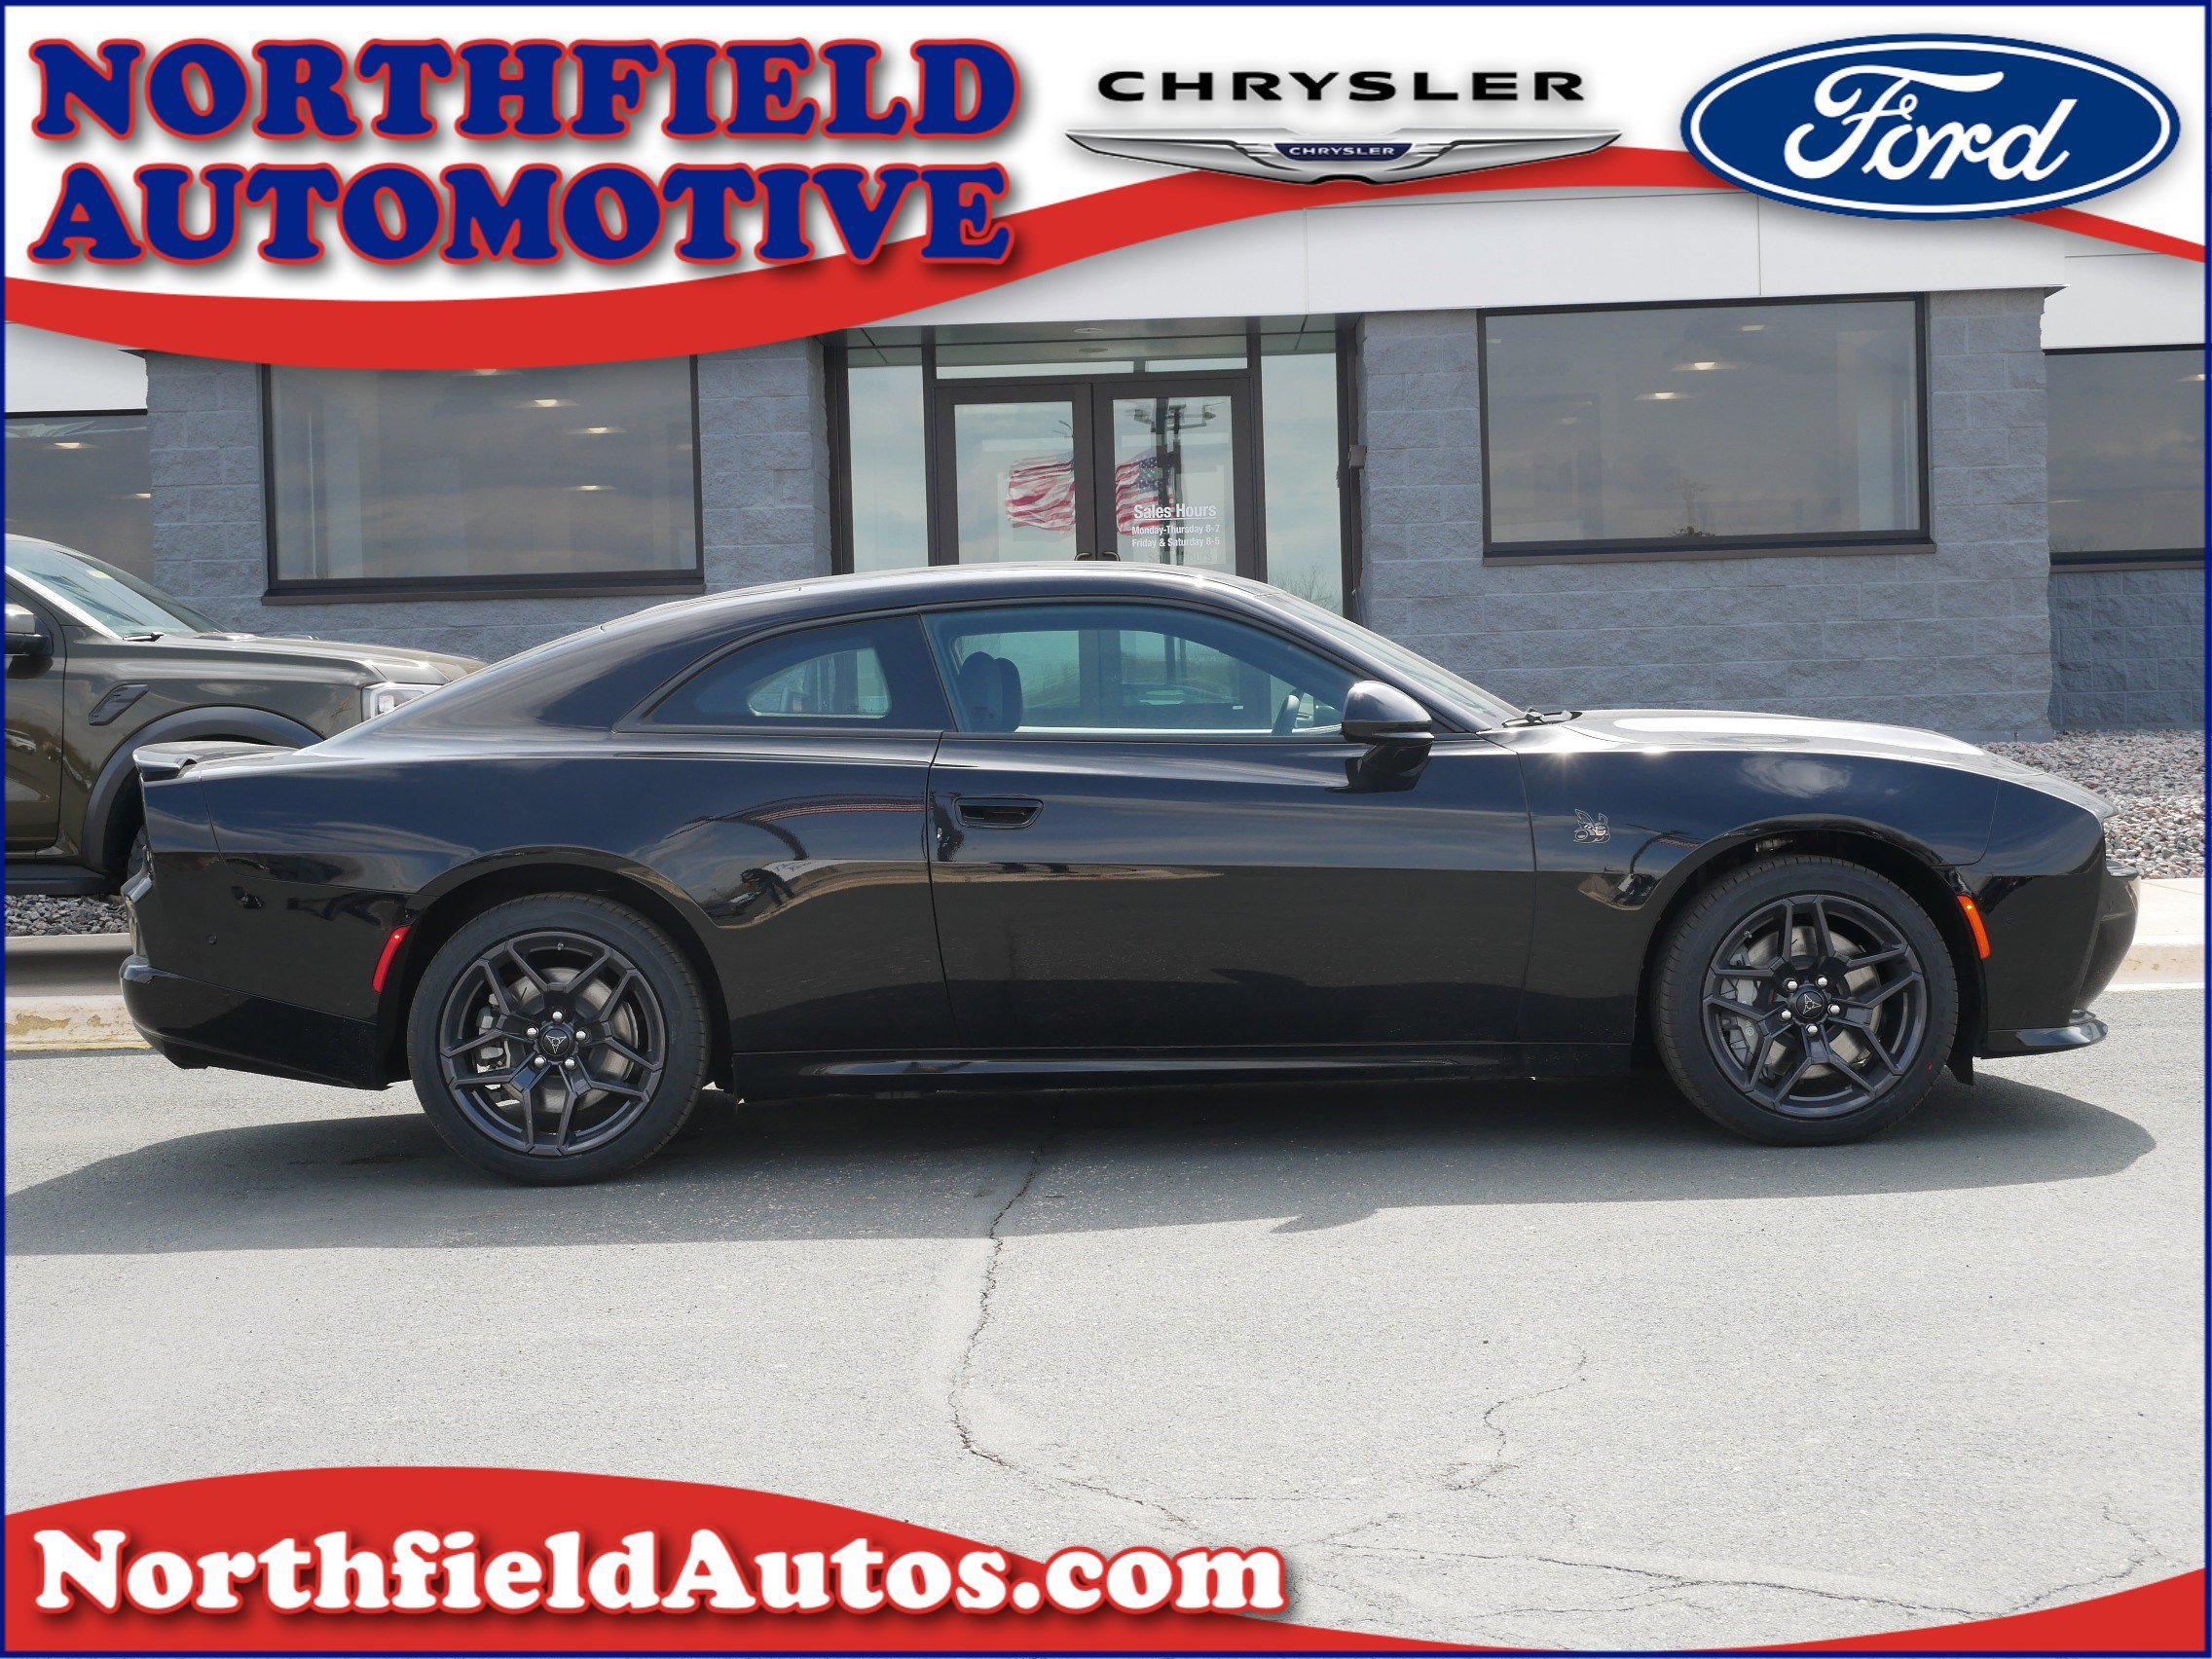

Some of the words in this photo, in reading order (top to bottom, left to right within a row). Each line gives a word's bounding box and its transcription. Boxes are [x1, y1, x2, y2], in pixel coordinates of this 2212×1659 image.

[1133, 504, 1171, 519] Sales
[1175, 503, 1217, 518] Hours
[1131, 525, 1203, 535] Monday-Thursday
[1205, 524, 1220, 534] 8-7
[1131, 538, 1157, 548] Friday
[1159, 537, 1166, 547] &
[1167, 537, 1204, 547] Saturday
[1205, 536, 1220, 545] 8-5
